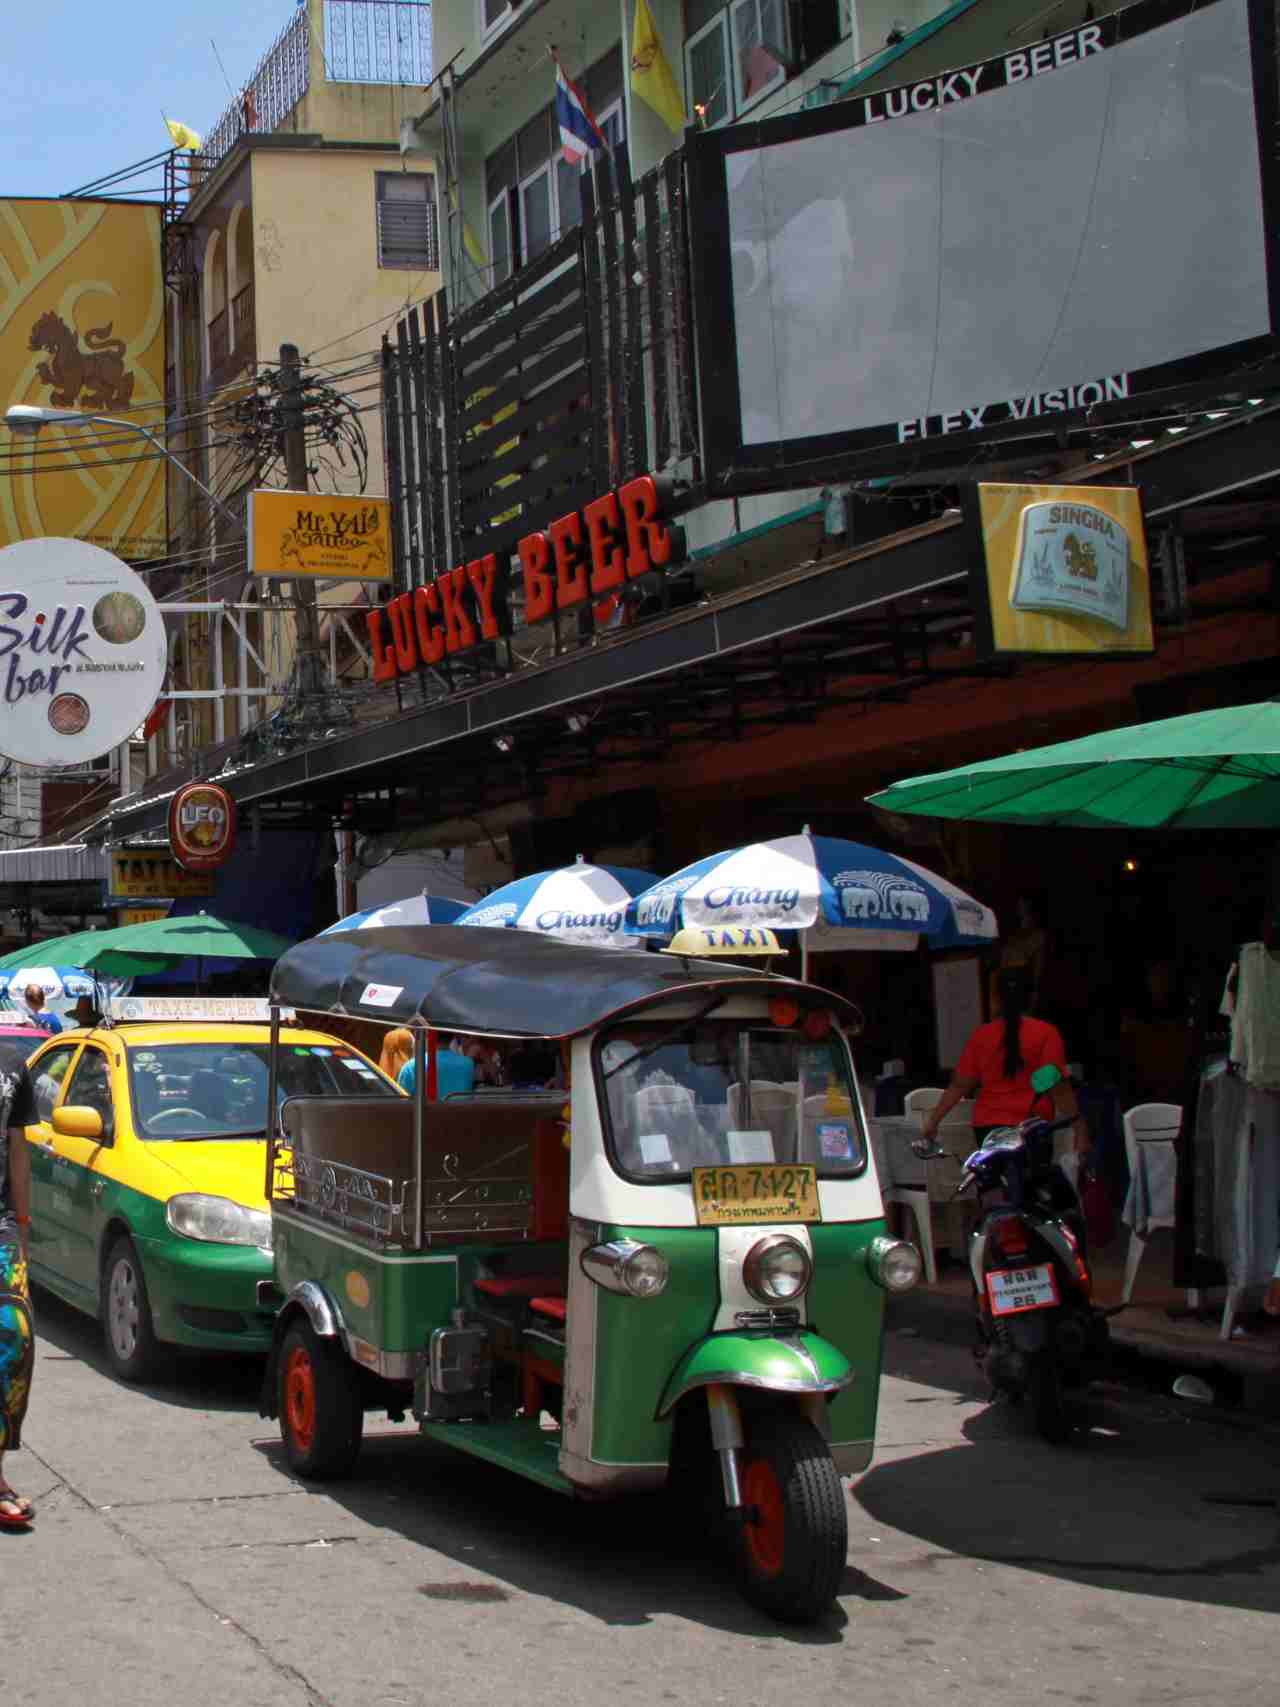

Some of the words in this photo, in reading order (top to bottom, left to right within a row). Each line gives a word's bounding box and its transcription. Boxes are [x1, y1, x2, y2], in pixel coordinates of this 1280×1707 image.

[864, 66, 984, 124] LUCKY
[1004, 25, 1105, 85] BEER
[1008, 372, 1129, 420] VISION
[1048, 507, 1116, 540] SINGHA
[366, 553, 499, 686] LUCKY
[517, 475, 670, 625] BEER
[5, 653, 72, 703] bar
[181, 806, 224, 825] UFO
[703, 885, 801, 911] Chang
[536, 909, 623, 932] Chang
[704, 929, 770, 947] TAXI
